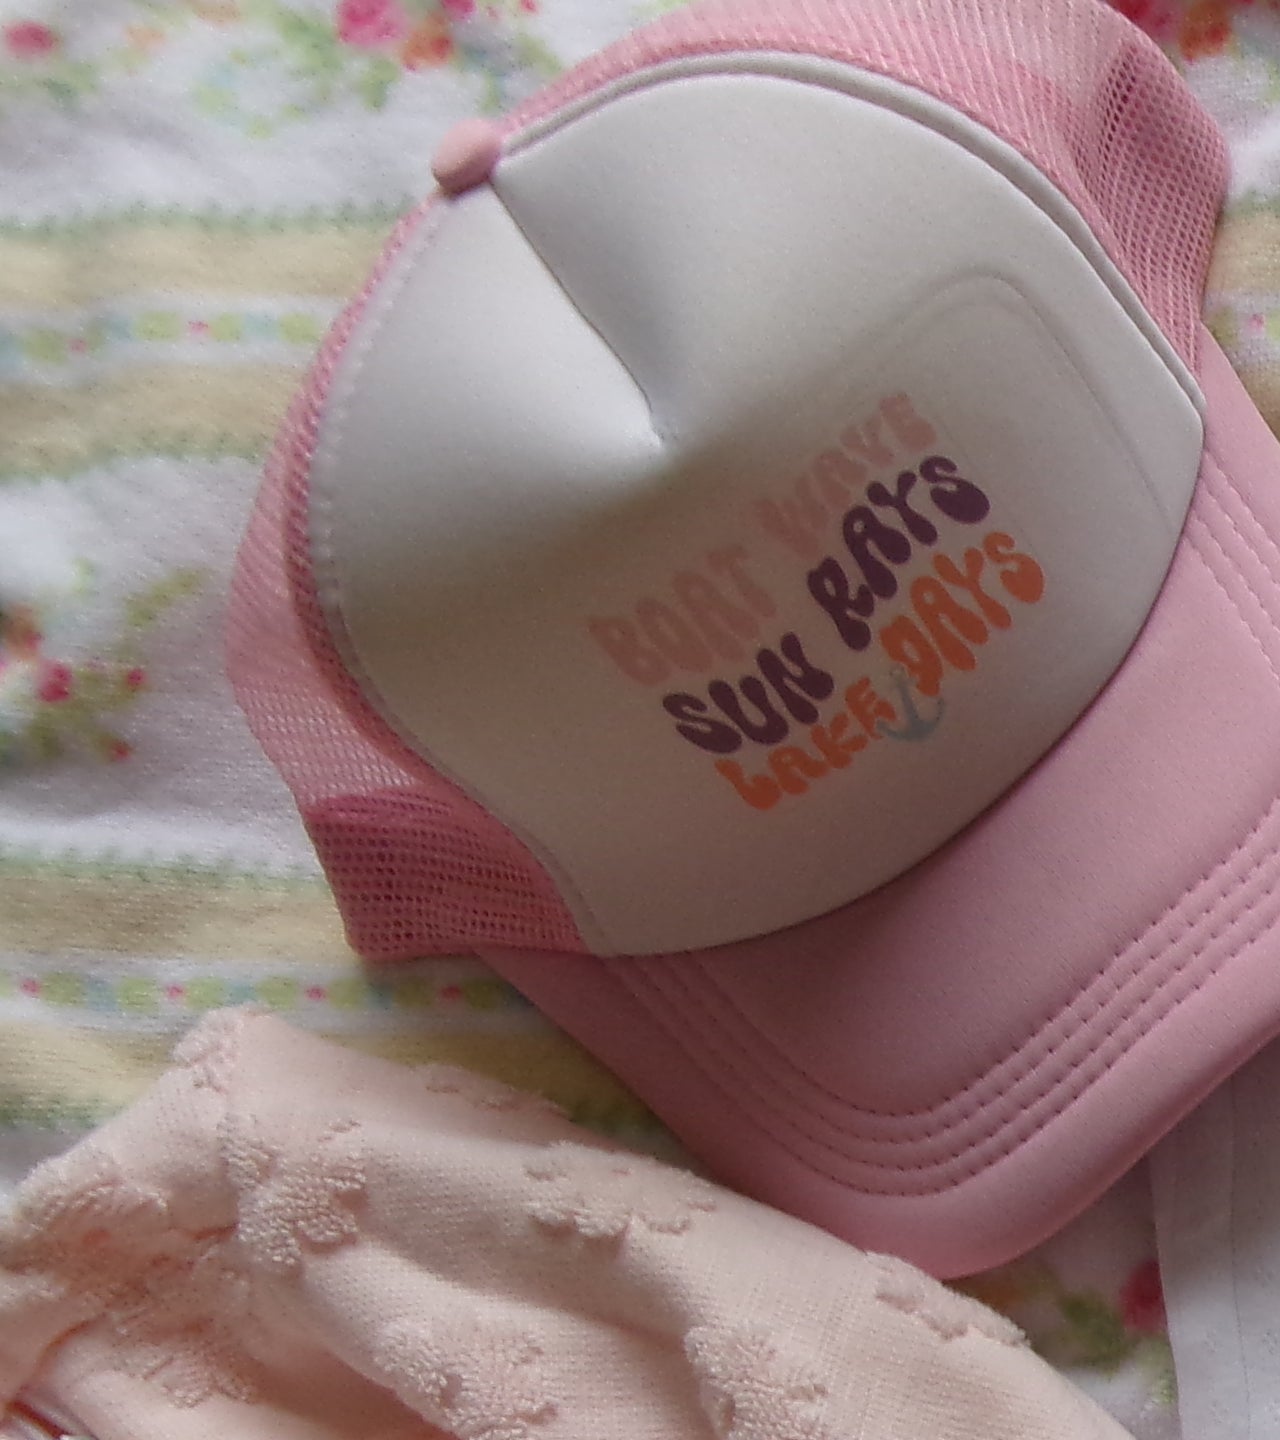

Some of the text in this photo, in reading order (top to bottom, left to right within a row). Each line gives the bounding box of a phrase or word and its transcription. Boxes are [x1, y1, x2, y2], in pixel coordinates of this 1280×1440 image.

[588, 542, 778, 687] BOAT
[662, 456, 991, 754] SUN RAYS
[714, 531, 1045, 810] LAKE DAYS
